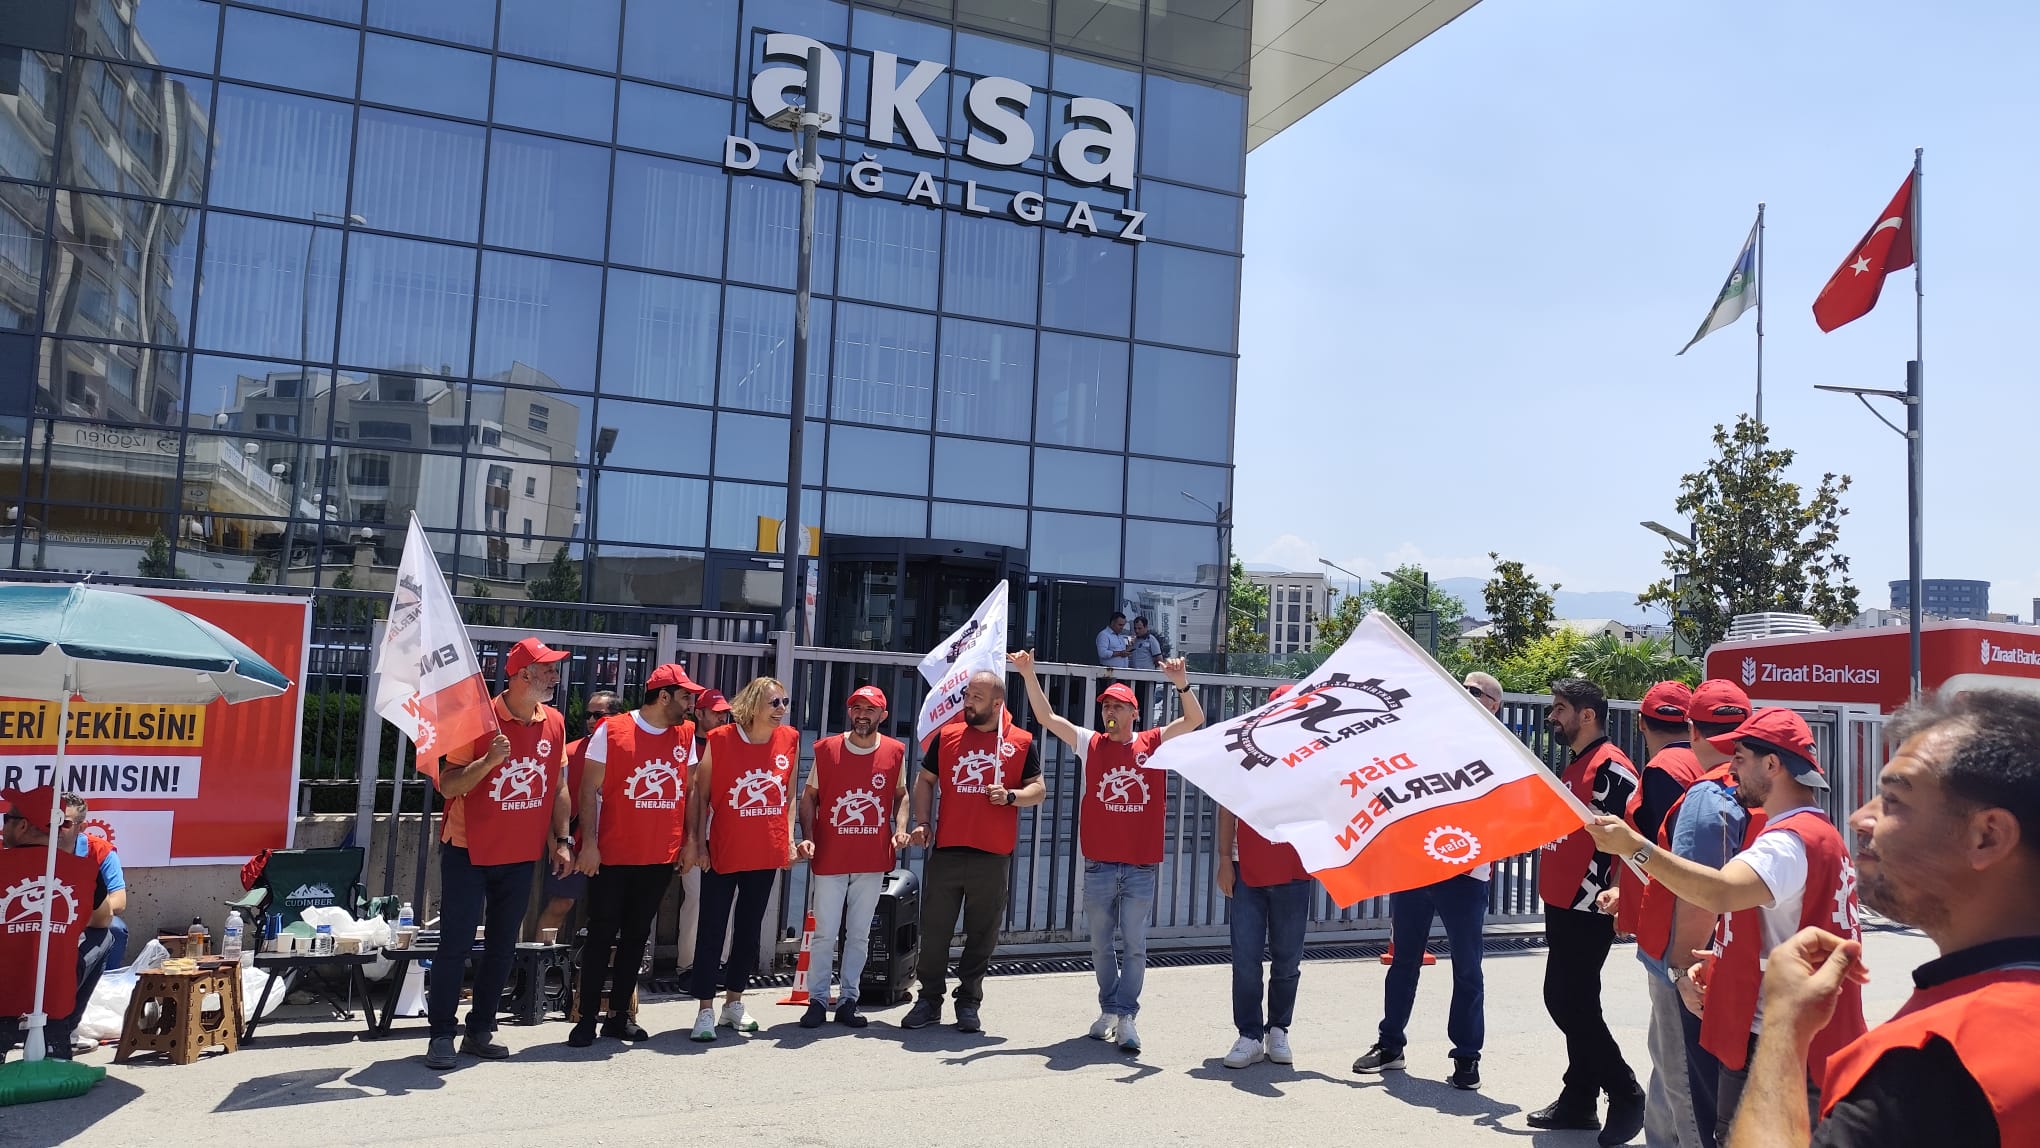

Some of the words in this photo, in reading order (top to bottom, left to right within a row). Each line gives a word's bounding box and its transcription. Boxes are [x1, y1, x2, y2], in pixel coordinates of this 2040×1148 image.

[725, 135, 1147, 242] DOĞALGAZ
[1991, 645, 2017, 663] Ziraat
[1761, 662, 1810, 683] Ziraat
[1812, 665, 1880, 684] Bankası
[0, 705, 46, 738] ERİ
